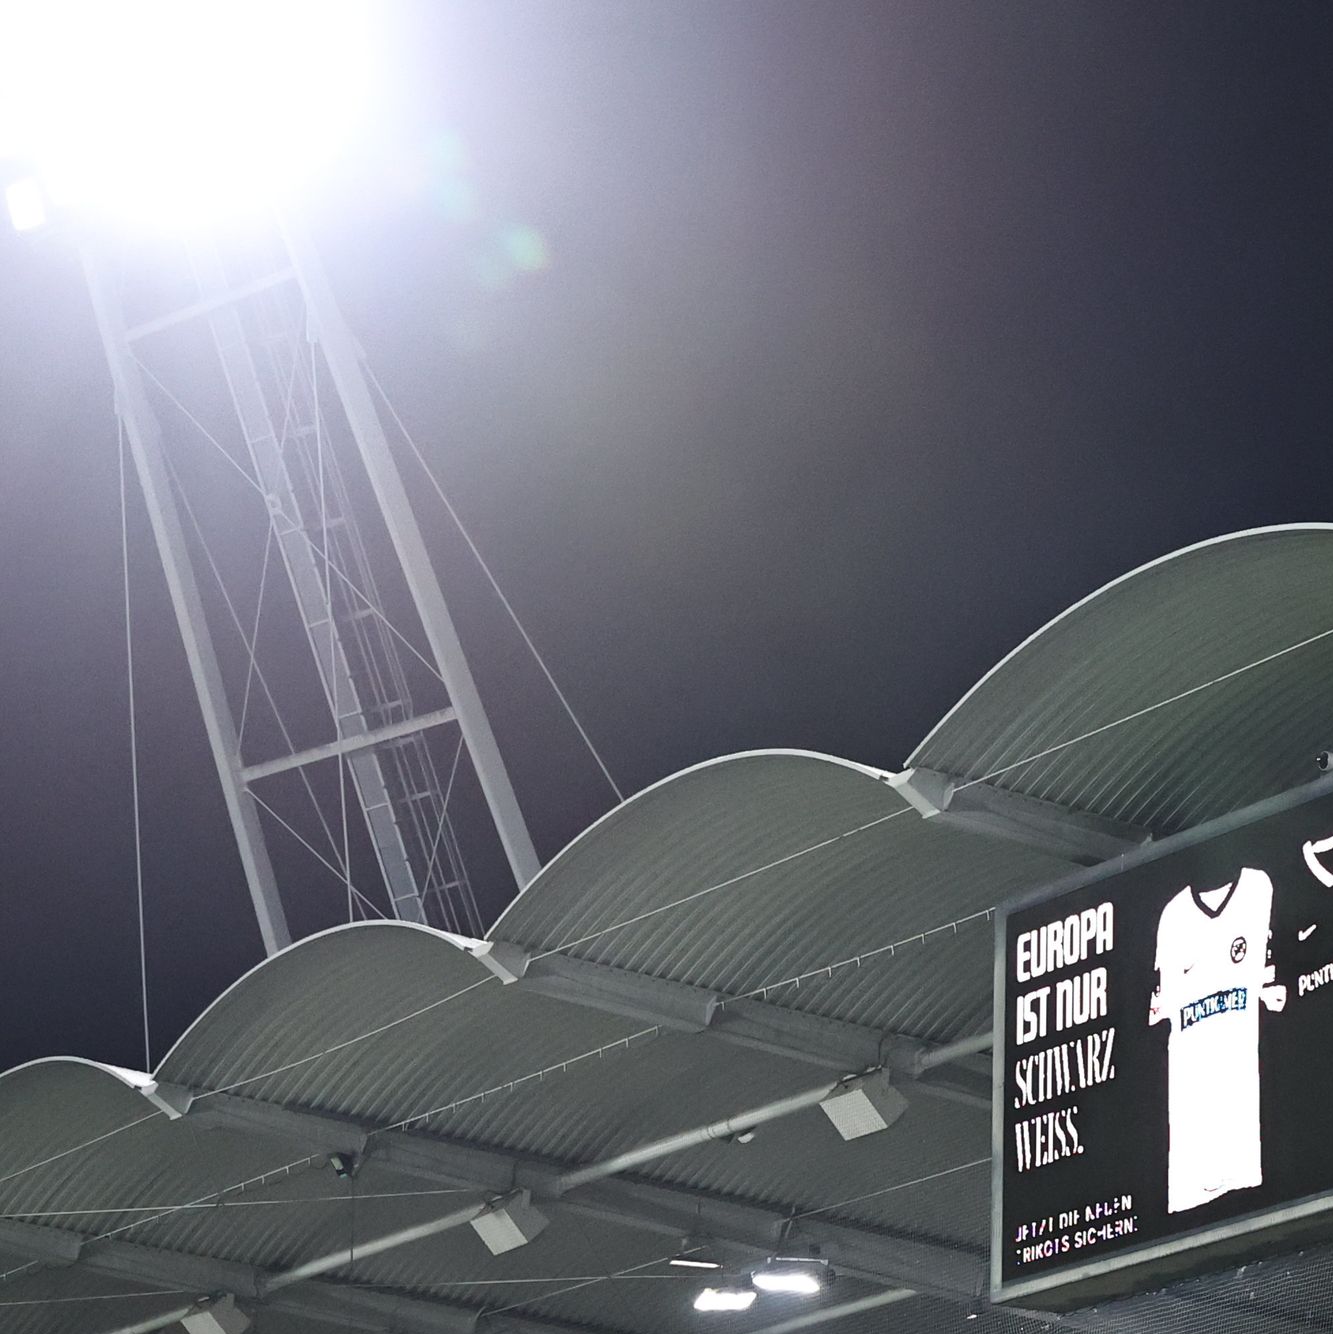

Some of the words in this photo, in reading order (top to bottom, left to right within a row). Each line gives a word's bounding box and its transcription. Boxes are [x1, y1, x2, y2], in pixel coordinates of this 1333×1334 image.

[1016, 902, 1114, 983] EUROPA
[1016, 983, 1051, 1045] IST
[1056, 967, 1108, 1032] NUR
[1014, 1028, 1115, 1109] SCHWARZ
[1015, 1107, 1084, 1172] WEISS.
